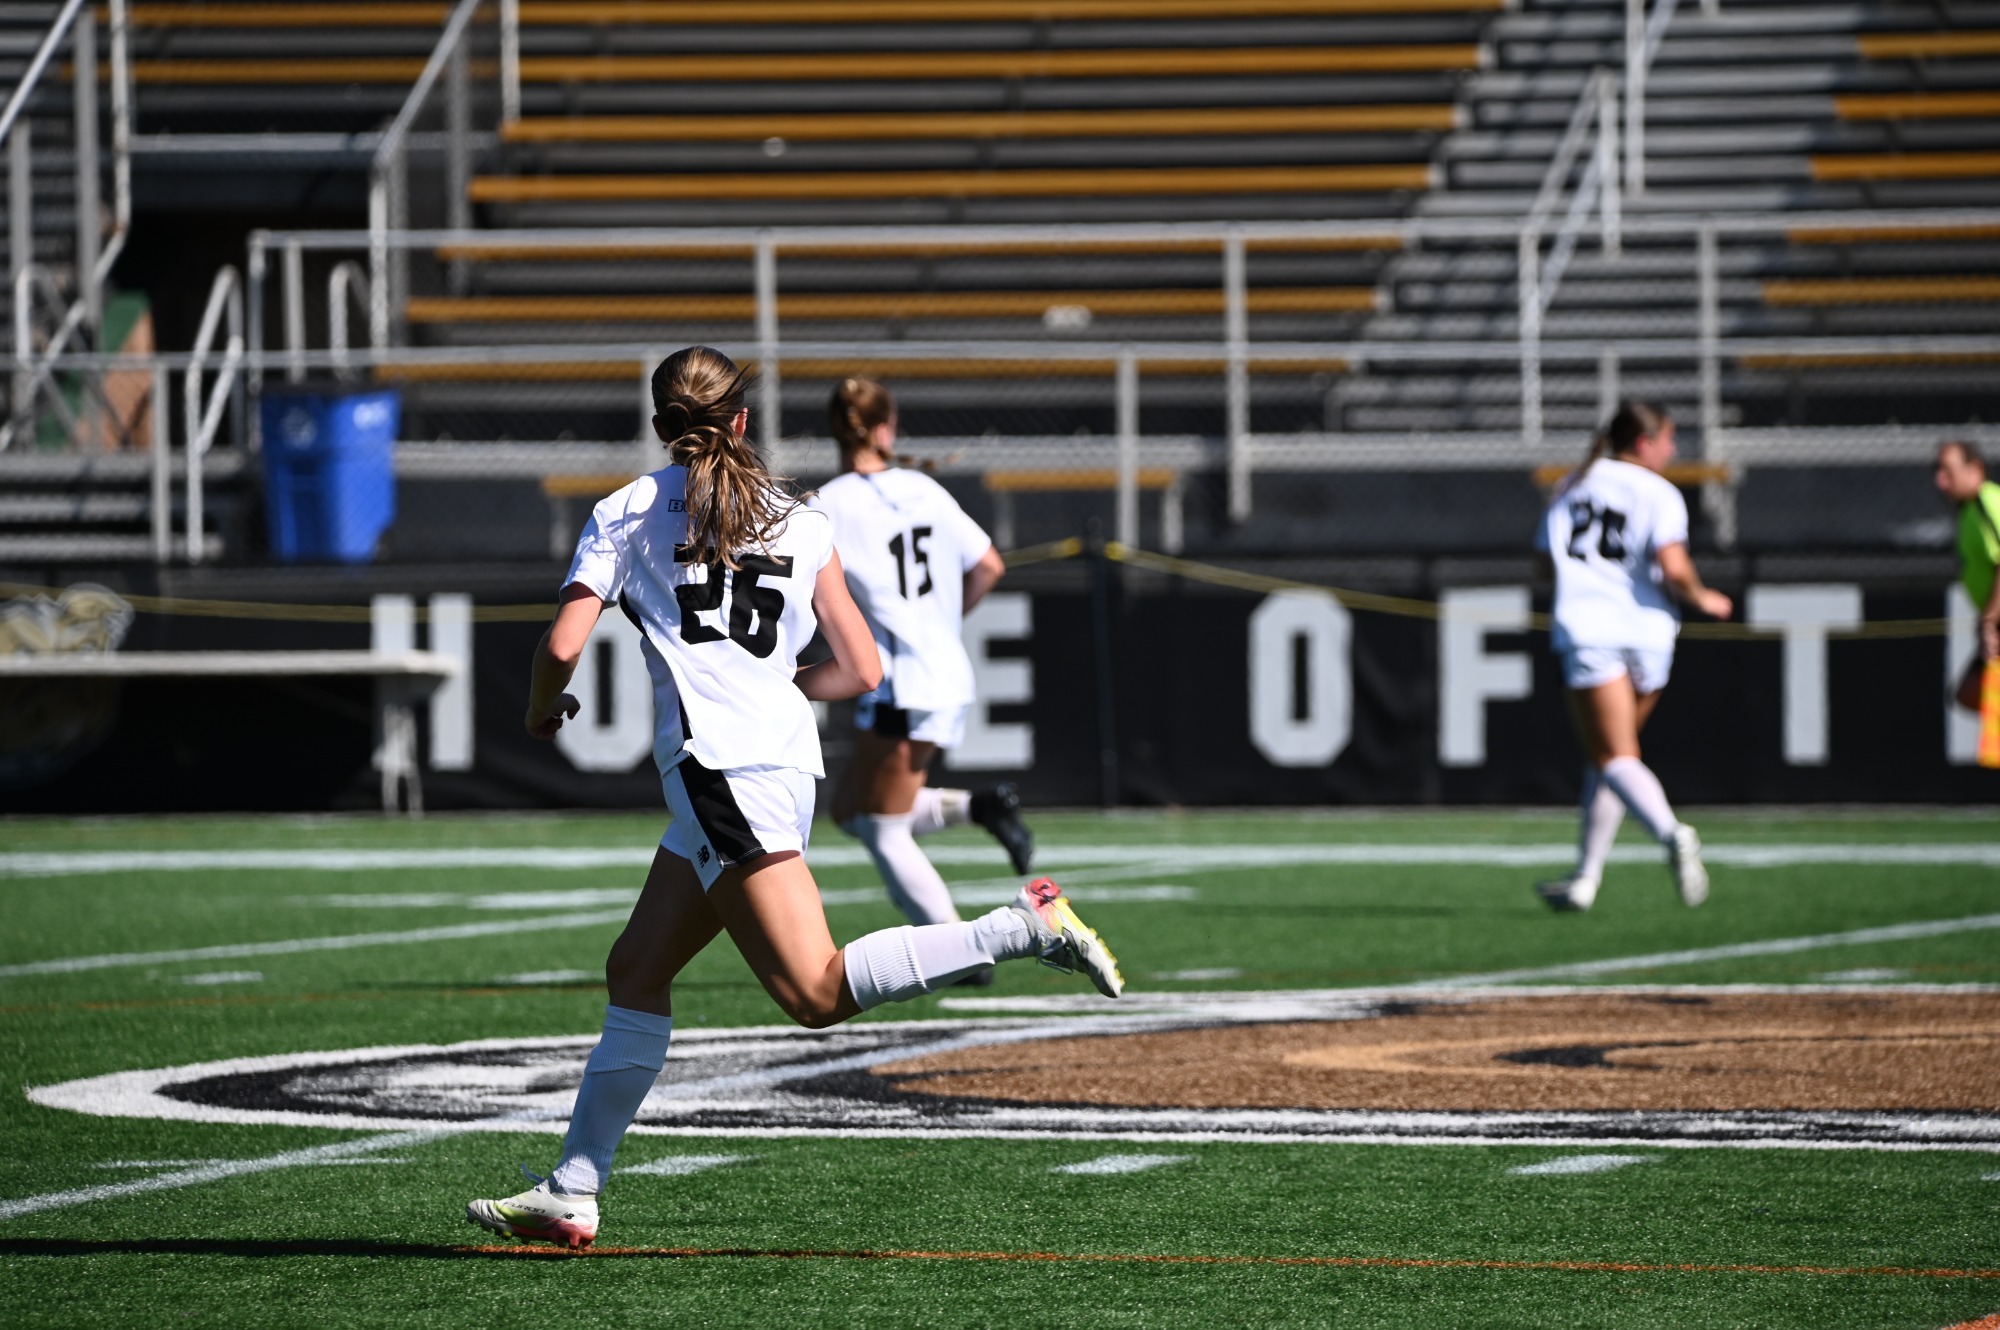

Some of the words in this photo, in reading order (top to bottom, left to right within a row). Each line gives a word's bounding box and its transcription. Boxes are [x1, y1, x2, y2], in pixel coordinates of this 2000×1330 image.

[673, 544, 794, 658] 26
[889, 526, 932, 599] 15
[371, 593, 1034, 771] HOE
[1249, 587, 1533, 767] OF
